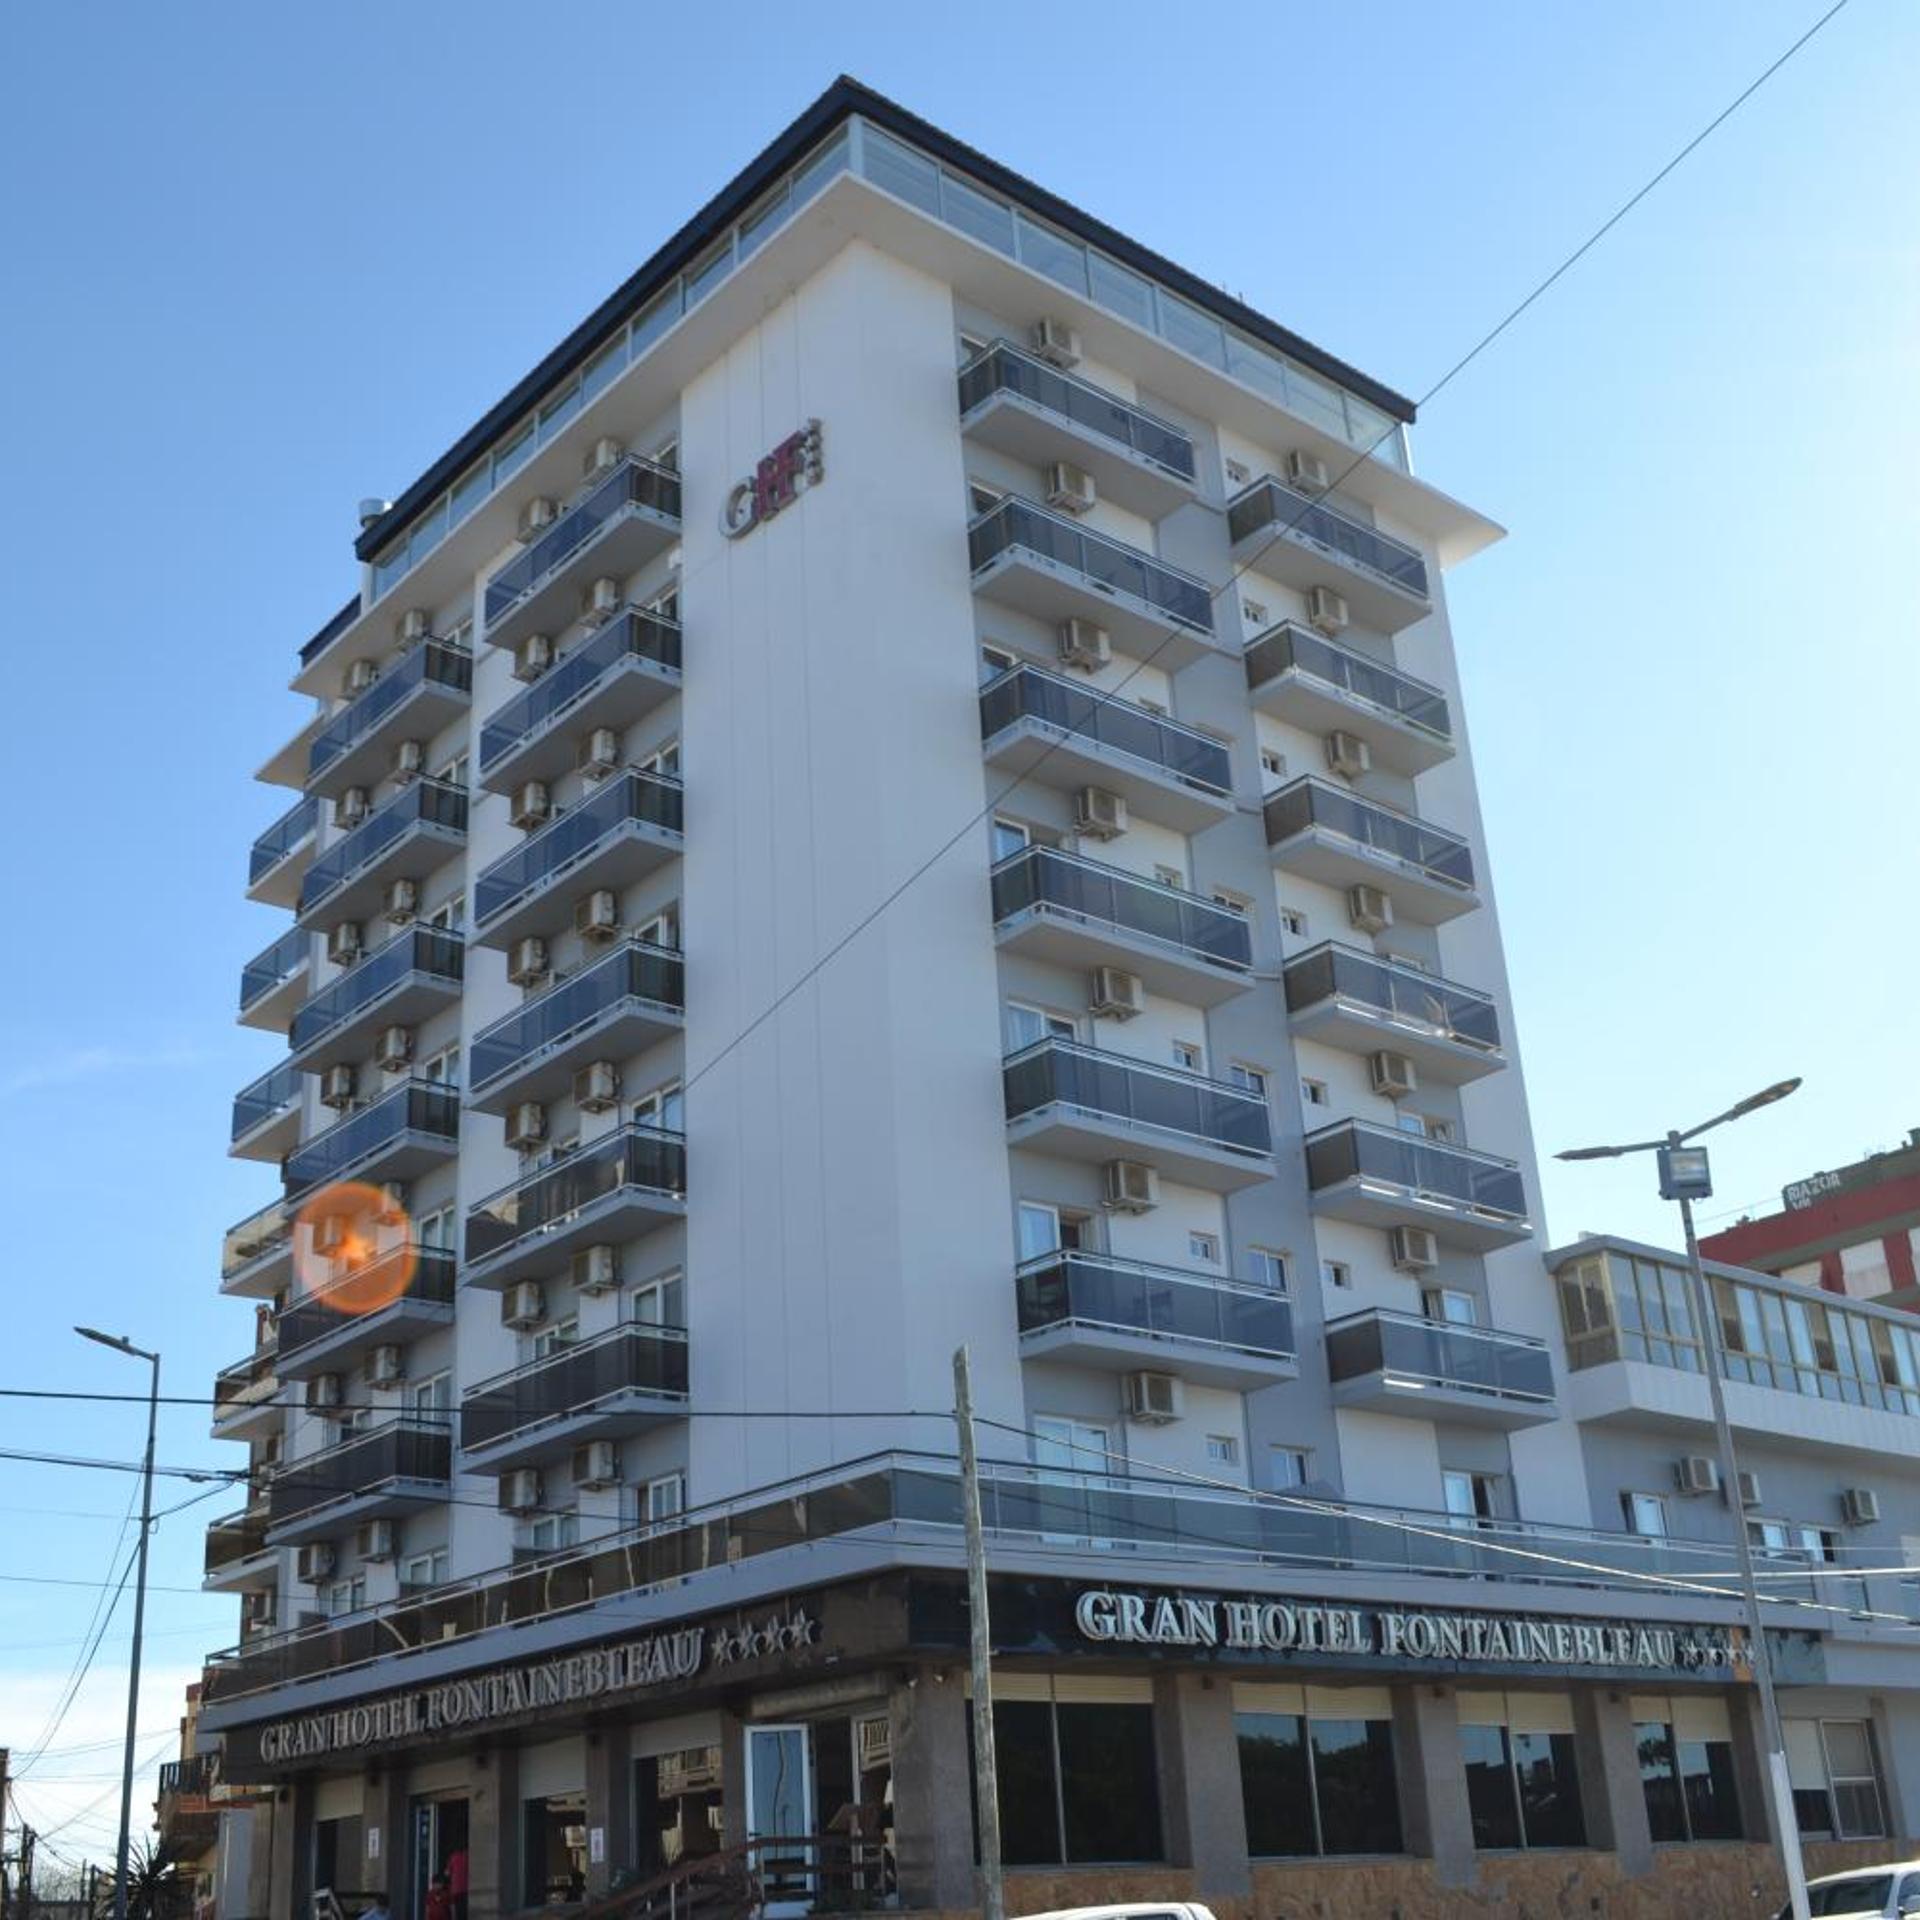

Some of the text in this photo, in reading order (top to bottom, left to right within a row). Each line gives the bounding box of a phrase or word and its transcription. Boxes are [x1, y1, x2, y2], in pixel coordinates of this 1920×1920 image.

[1076, 1590, 1676, 1668] GRAN HOTEL FONTAINEBLEAU
[260, 1627, 705, 1763] GRAN HOTEL FONTAINEBLEAU
